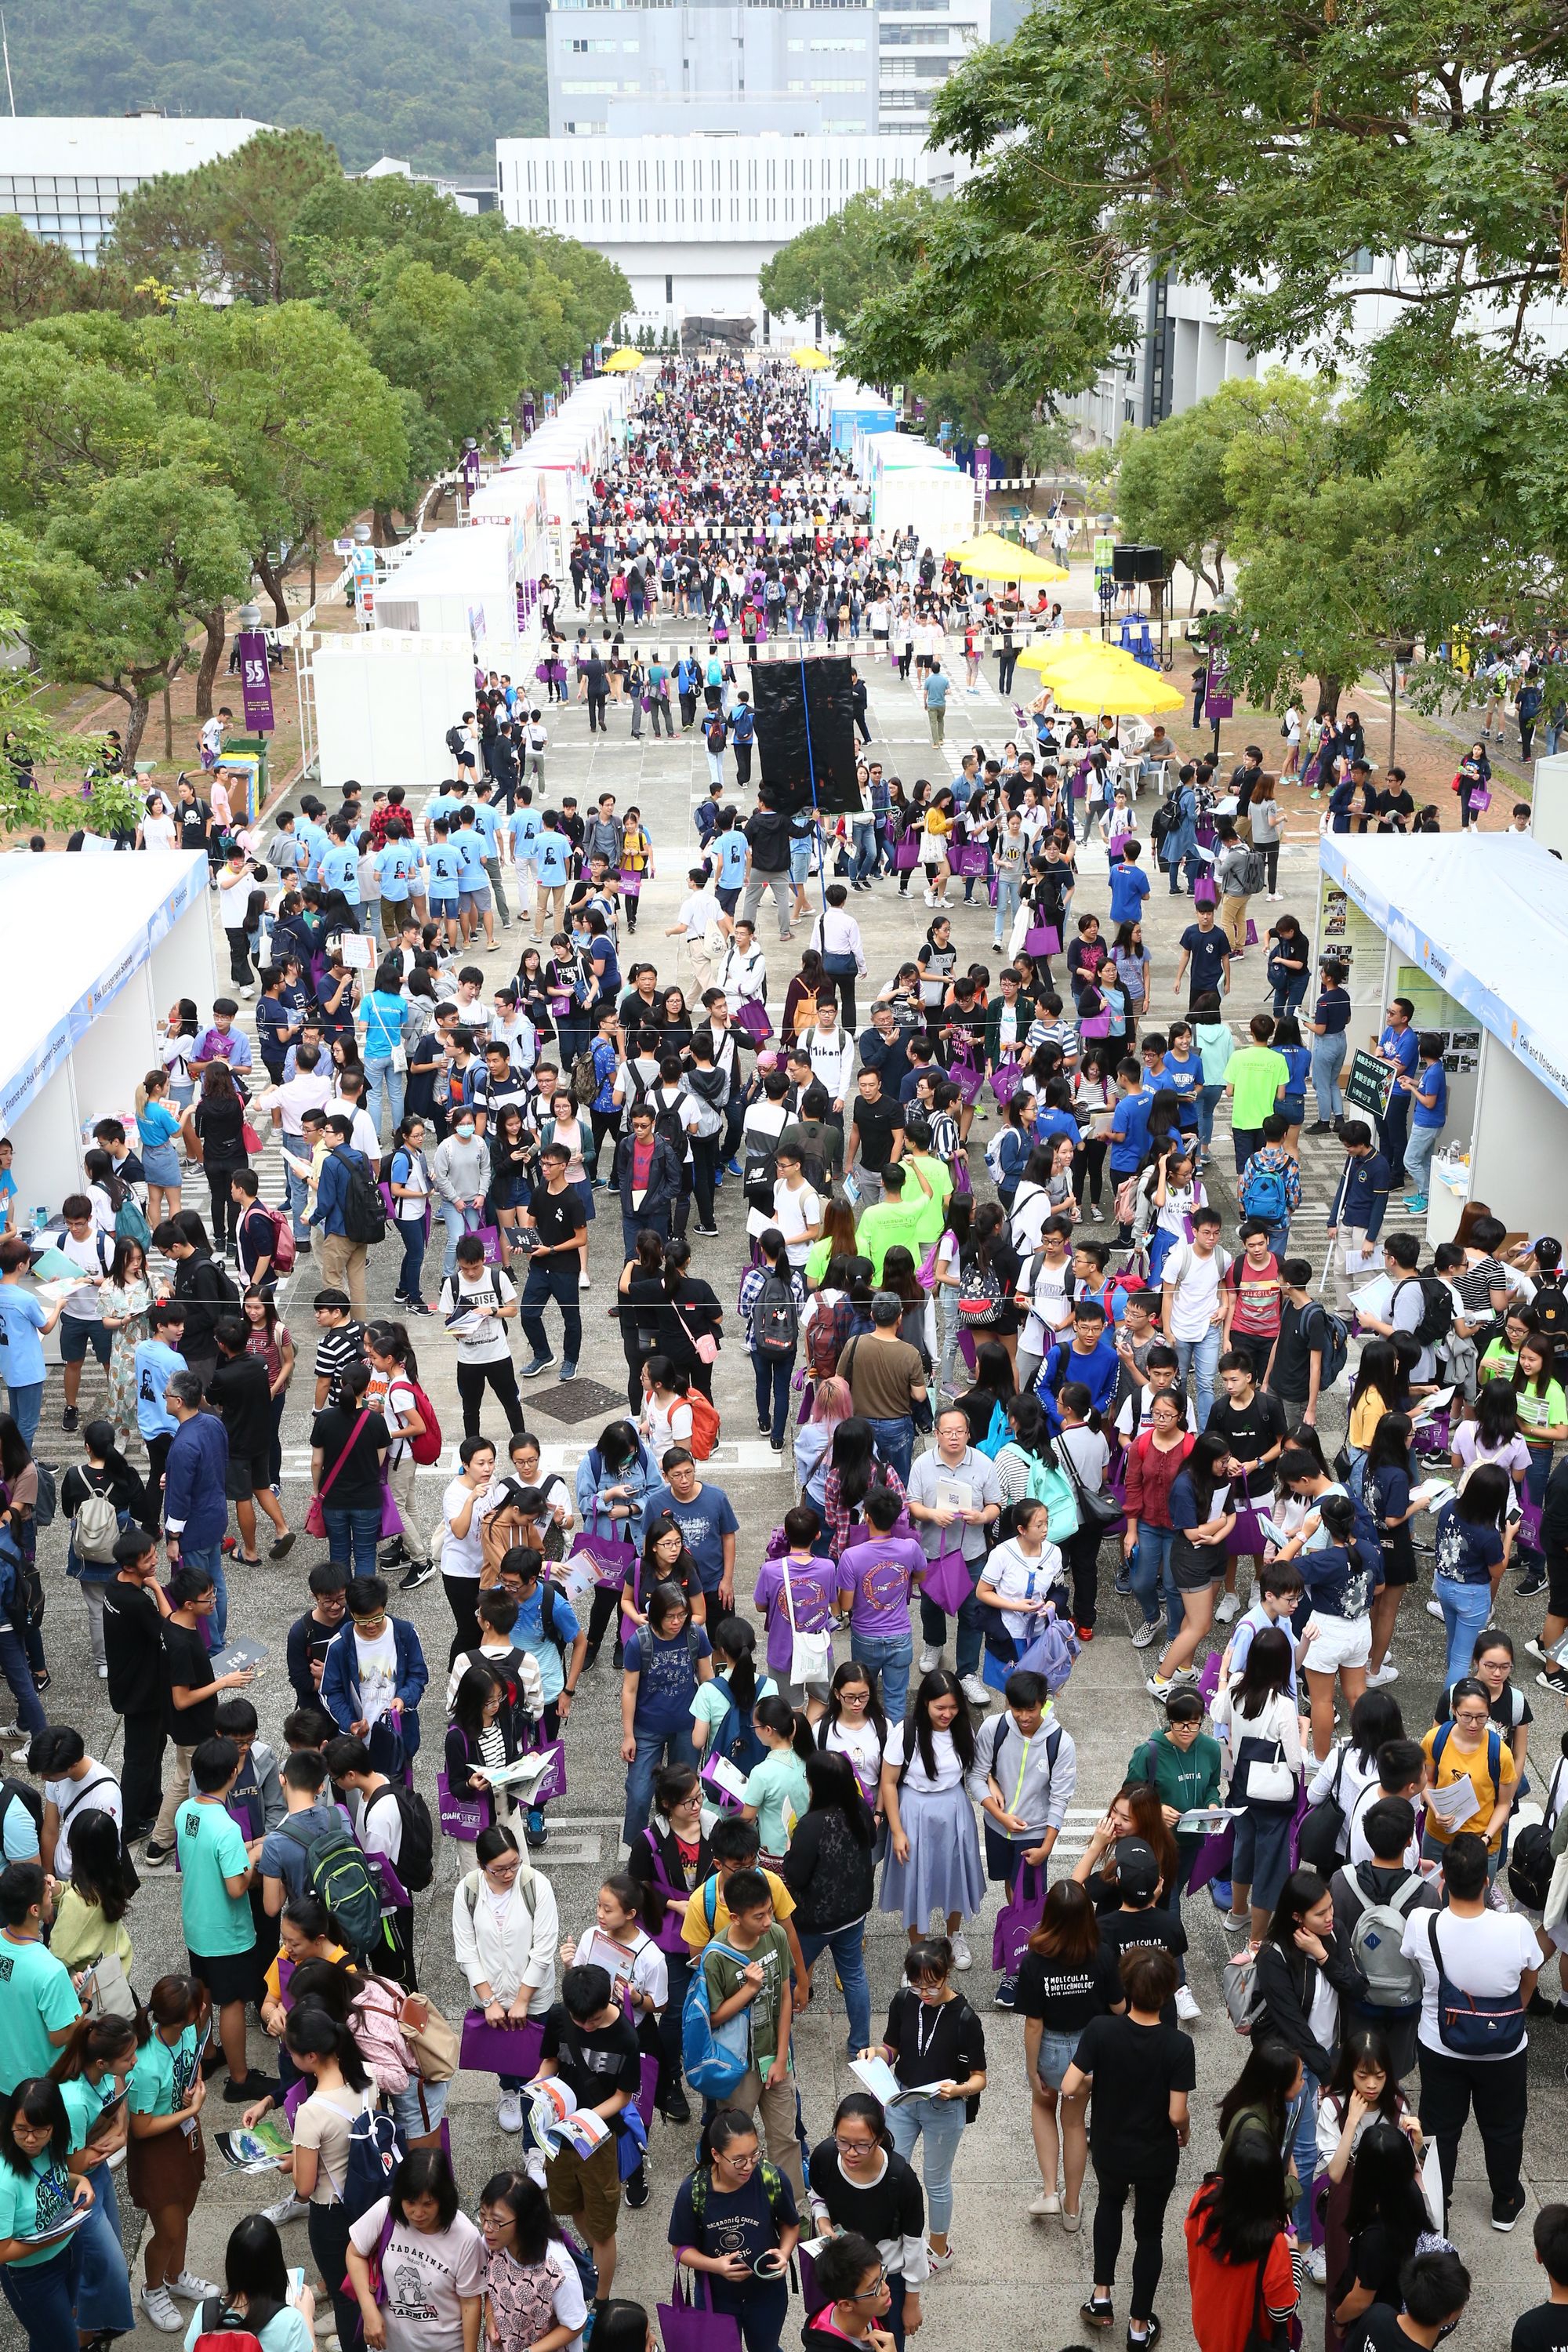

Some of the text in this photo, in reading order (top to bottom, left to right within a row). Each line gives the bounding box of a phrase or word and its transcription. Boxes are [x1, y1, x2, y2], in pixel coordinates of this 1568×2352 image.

[977, 463, 988, 477] 55
[245, 660, 265, 683] 55
[175, 887, 187, 908] Statistics
[1347, 873, 1367, 904] Biochemistry
[101, 965, 122, 996] Management
[120, 954, 132, 973] Science
[557, 965, 578, 975] KYOTO
[1430, 953, 1447, 979] Biology
[1519, 1034, 1530, 1052] Cell
[1529, 1047, 1538, 1061] and
[1537, 1051, 1562, 1083] Molecular
[5, 1091, 20, 1112] Finance
[26, 1073, 35, 1087] Risk
[34, 1048, 54, 1078] Management
[53, 1034, 66, 1054] Science
[804, 1610, 826, 1628] ECONOMICS
[441, 1811, 461, 1820] CUHK
[1125, 1938, 1162, 1950] MOLECULAR
[1051, 1974, 1089, 1984] MOLECULAR
[1051, 1981, 1094, 1992] BIOTECHNOLOGY
[740, 2216, 760, 2227] CHEESE
